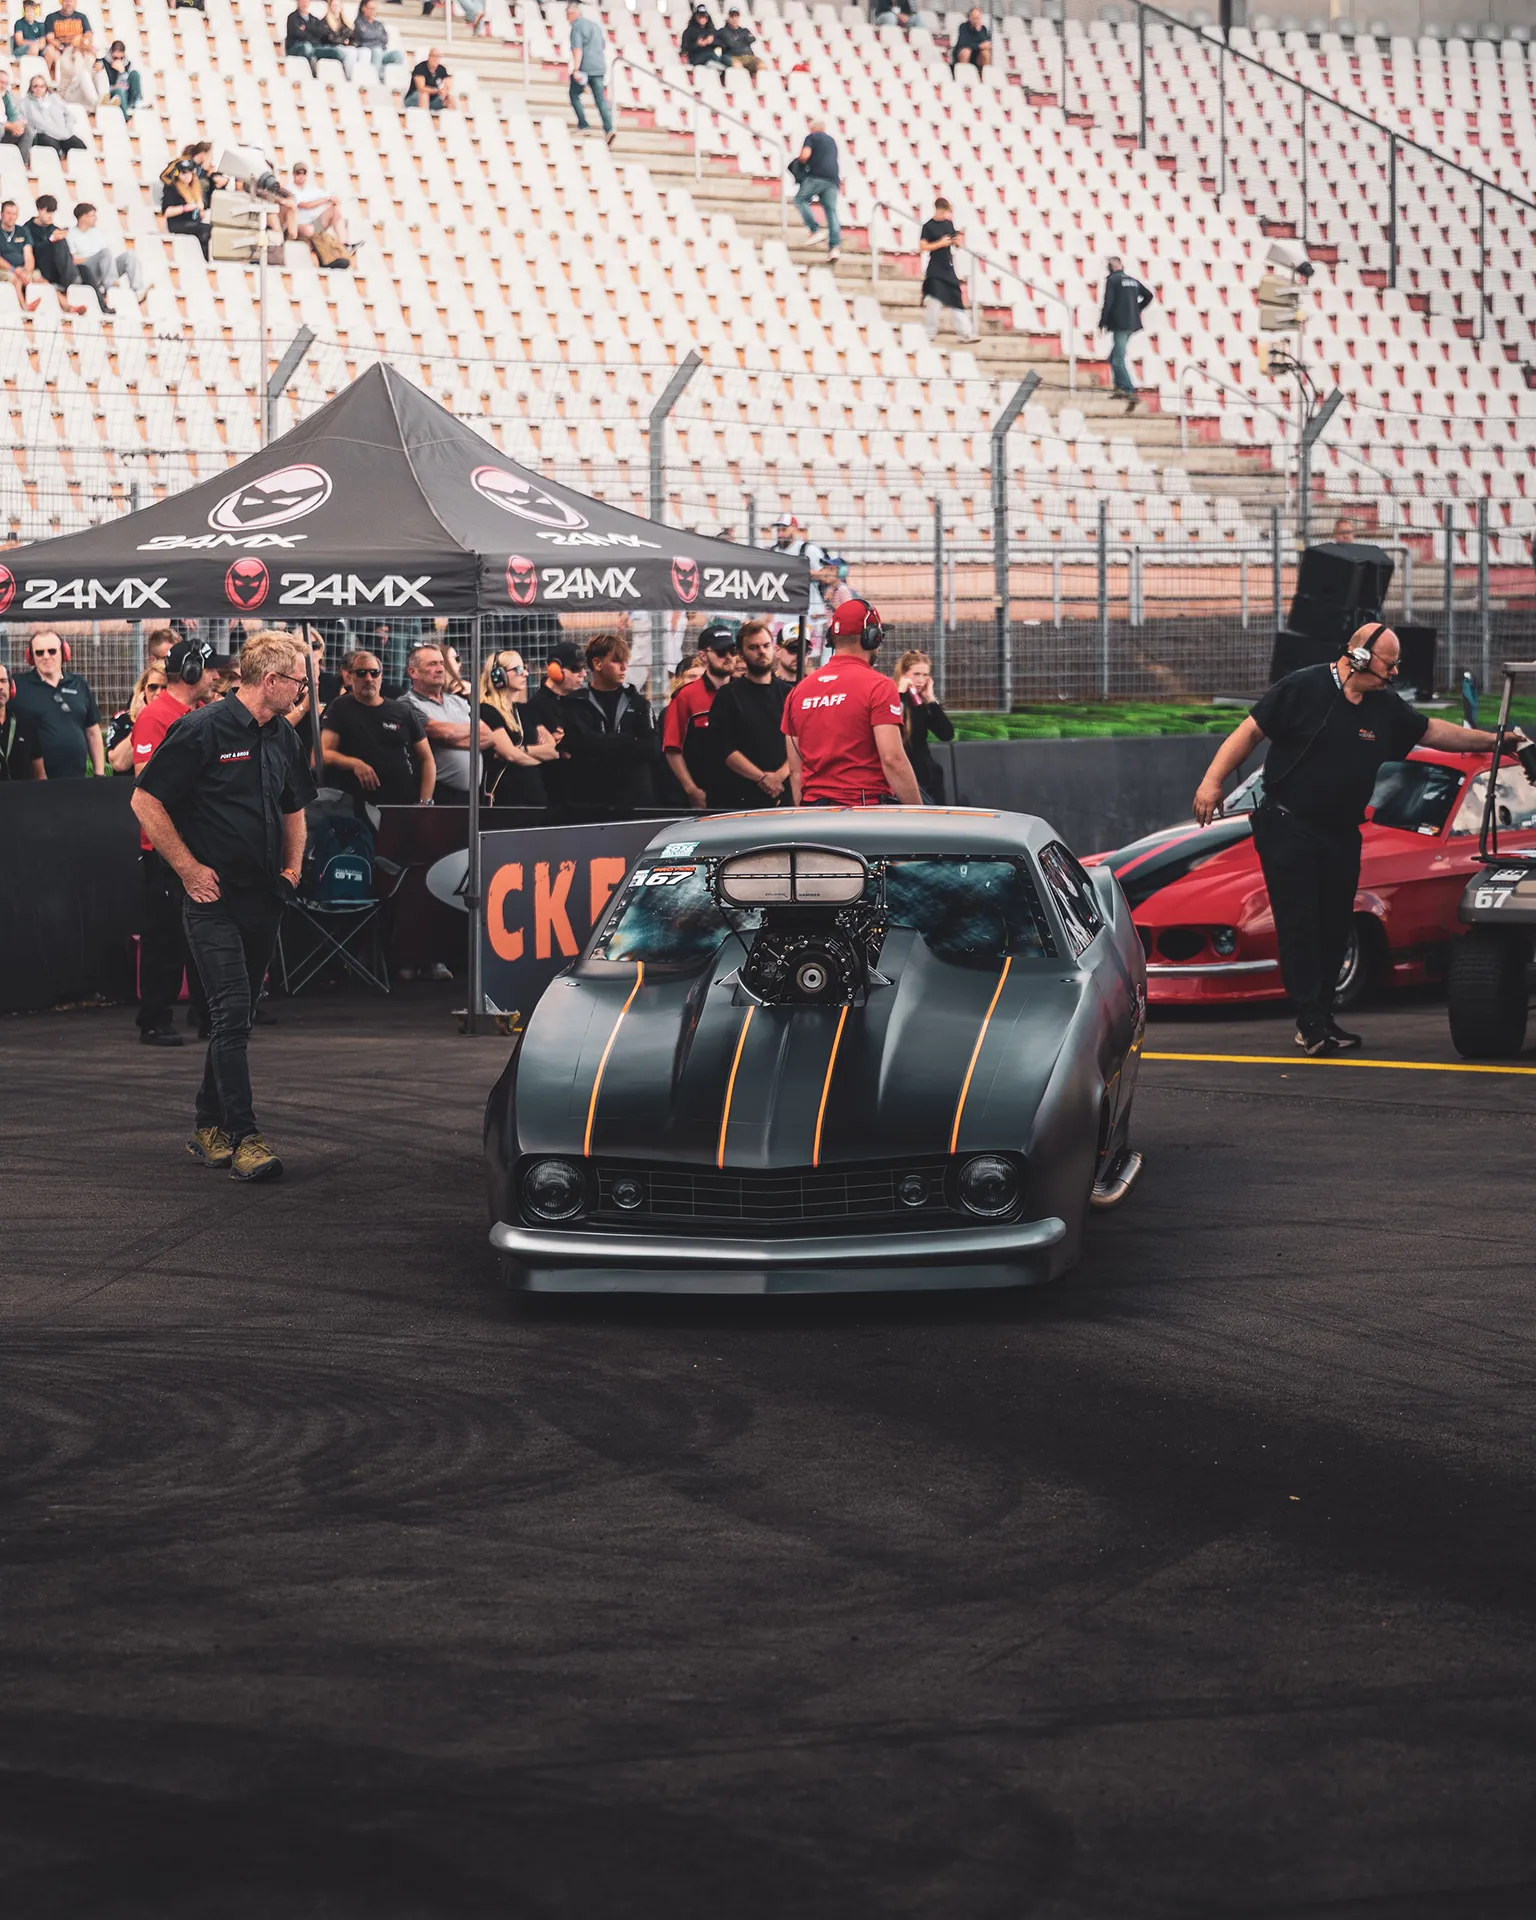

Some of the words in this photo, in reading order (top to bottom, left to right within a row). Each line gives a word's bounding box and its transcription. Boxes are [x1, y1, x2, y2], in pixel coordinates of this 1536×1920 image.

[137, 533, 308, 551] 24MX
[536, 531, 662, 549] 24MX
[279, 573, 435, 607] 24MX
[541, 566, 642, 600] 24MX
[703, 566, 790, 603] 24MX
[22, 577, 171, 609] 24MX
[801, 693, 848, 710] STAFF
[335, 871, 363, 881] GT3
[645, 871, 694, 886] 67
[1474, 890, 1512, 908] 67
